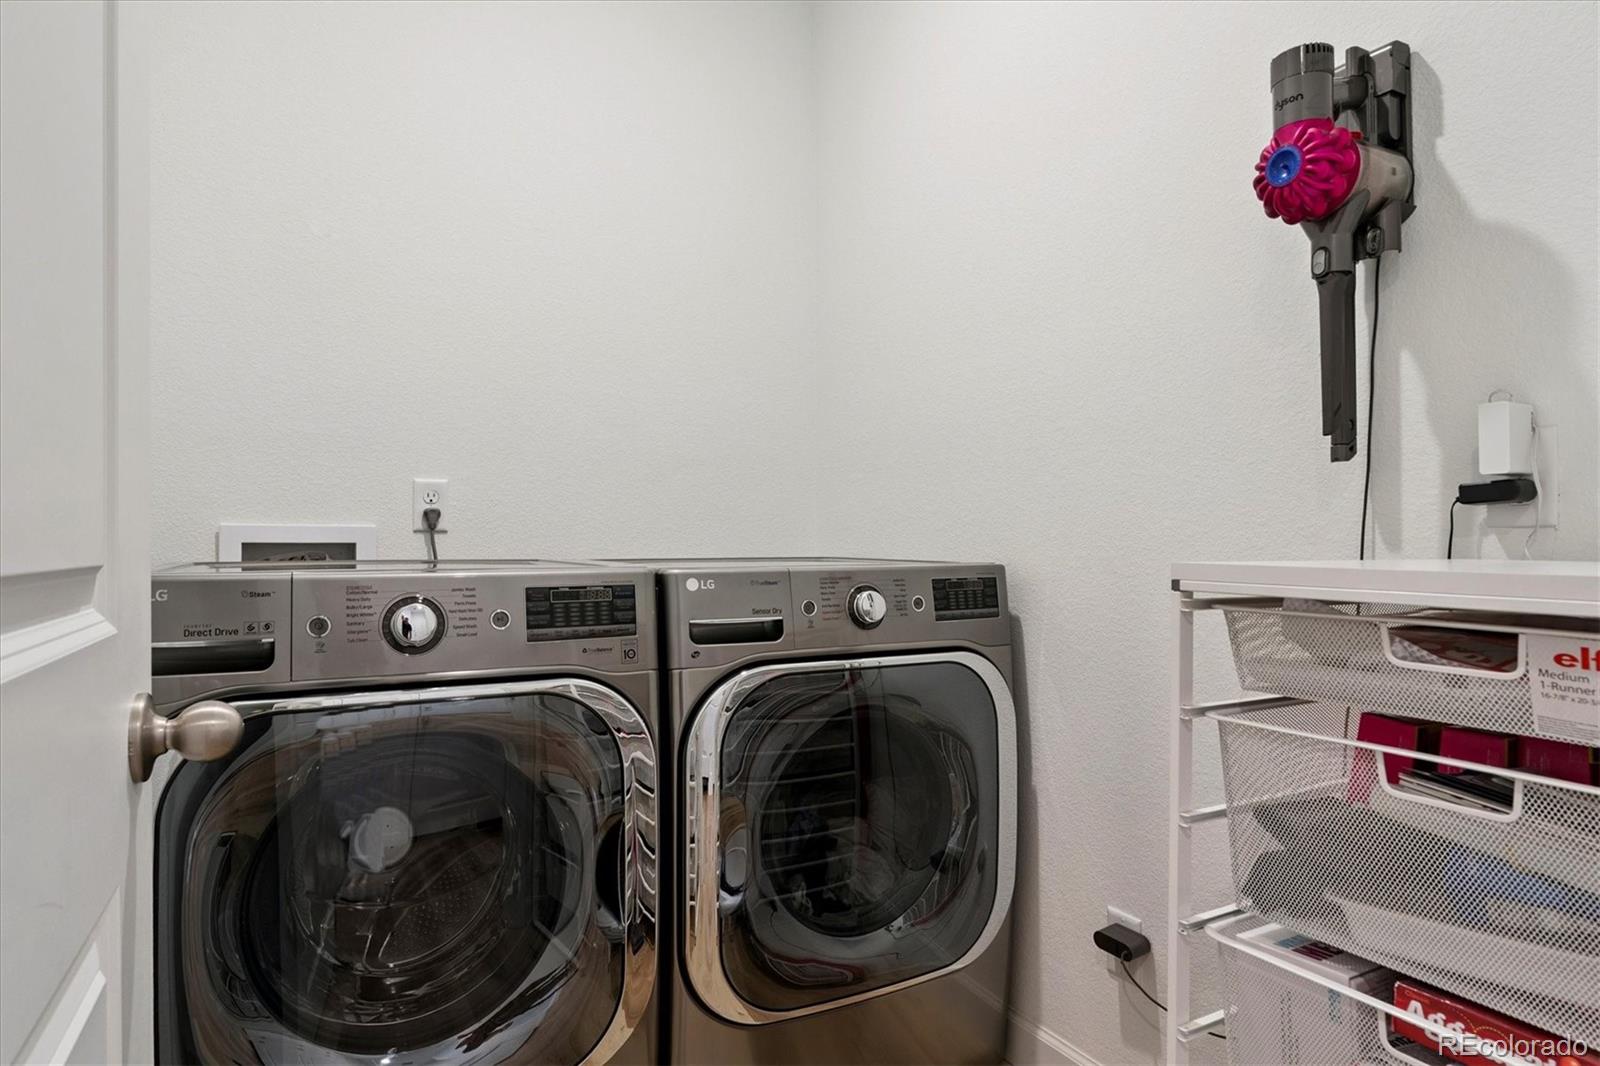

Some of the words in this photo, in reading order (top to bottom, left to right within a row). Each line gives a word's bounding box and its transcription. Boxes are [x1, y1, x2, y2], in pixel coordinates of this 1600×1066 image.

[701, 580, 715, 589] LG
[772, 607, 783, 615] Dry
[183, 628, 213, 638] Direct
[214, 627, 239, 637] Drive
[1538, 668, 1591, 684] Medium
[1540, 680, 1596, 696] 1-Runner
